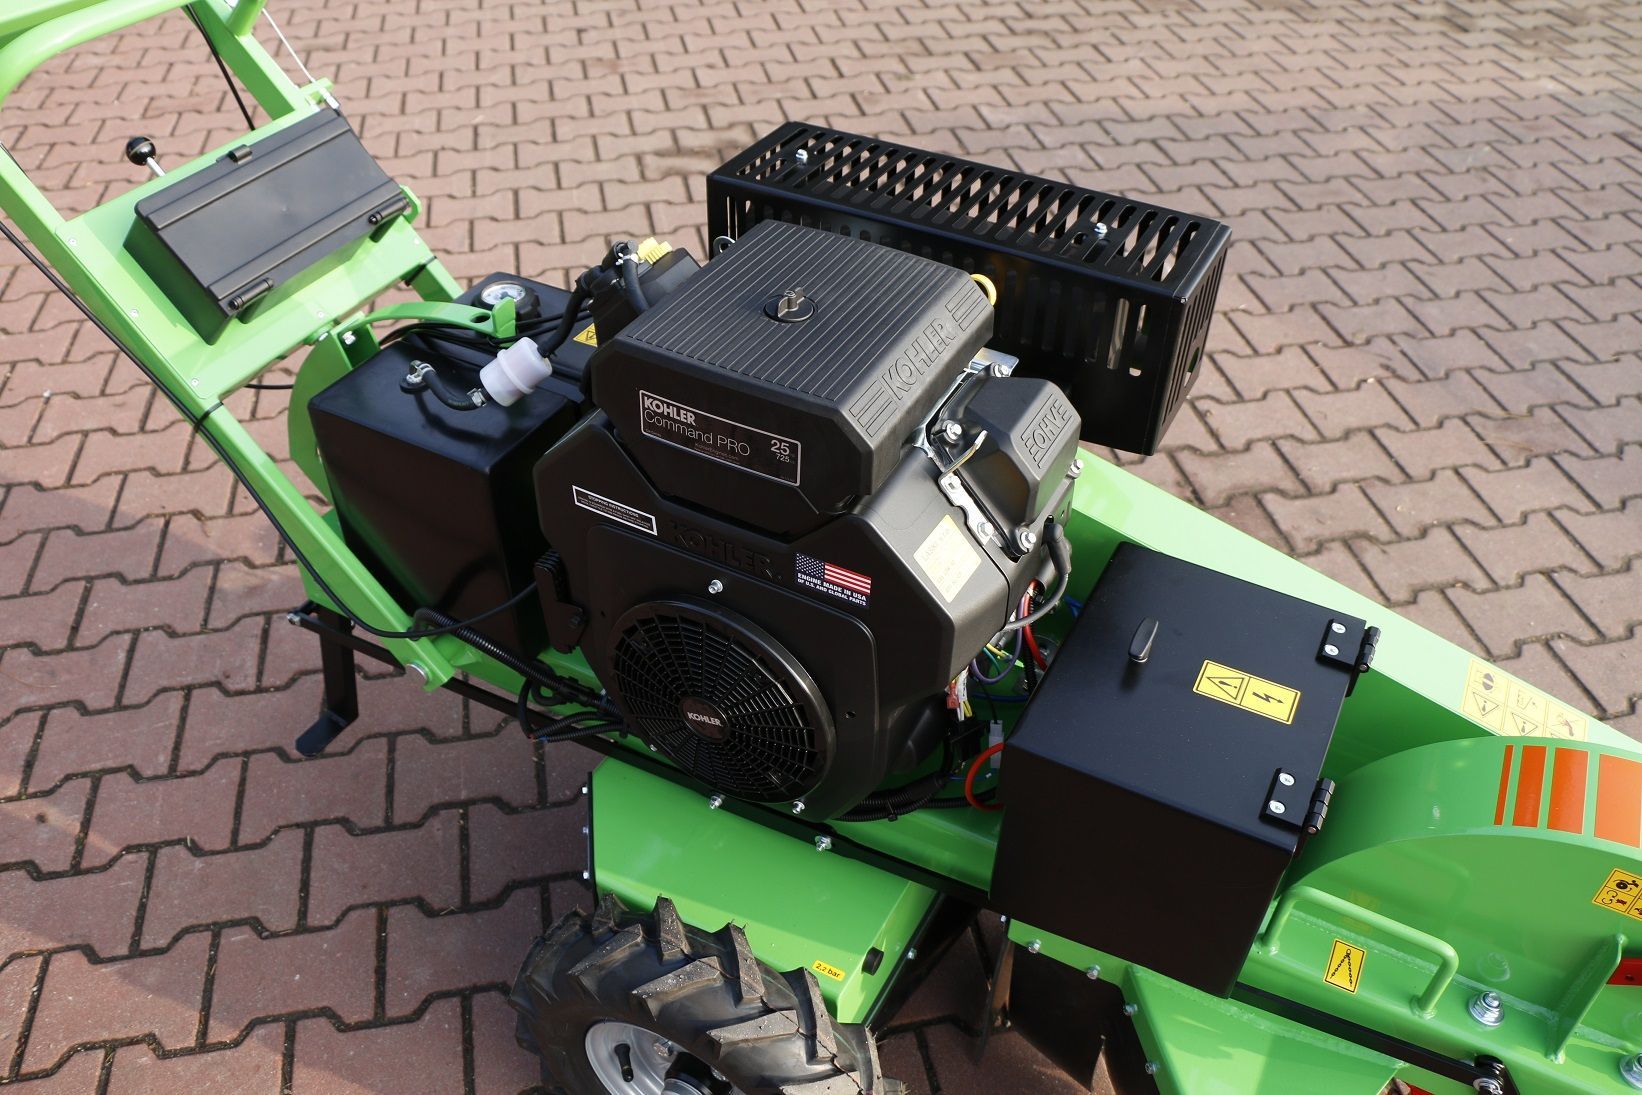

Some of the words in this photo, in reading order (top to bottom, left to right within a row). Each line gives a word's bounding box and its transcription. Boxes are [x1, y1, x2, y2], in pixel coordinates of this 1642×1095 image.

[882, 318, 957, 401] KOHLER
[644, 396, 696, 426] KOHLER
[644, 409, 713, 444] Command
[717, 435, 750, 456] PRO
[770, 440, 790, 456] 25
[776, 453, 790, 463] 725
[797, 573, 822, 585] ENGINE
[823, 582, 843, 593] MADE
[852, 592, 867, 601] USA
[828, 589, 849, 600] GLOBAL
[849, 596, 867, 606] PARTS
[686, 712, 722, 727] KOHLER
[816, 963, 827, 972] 2,2
[827, 967, 840, 977] bar
